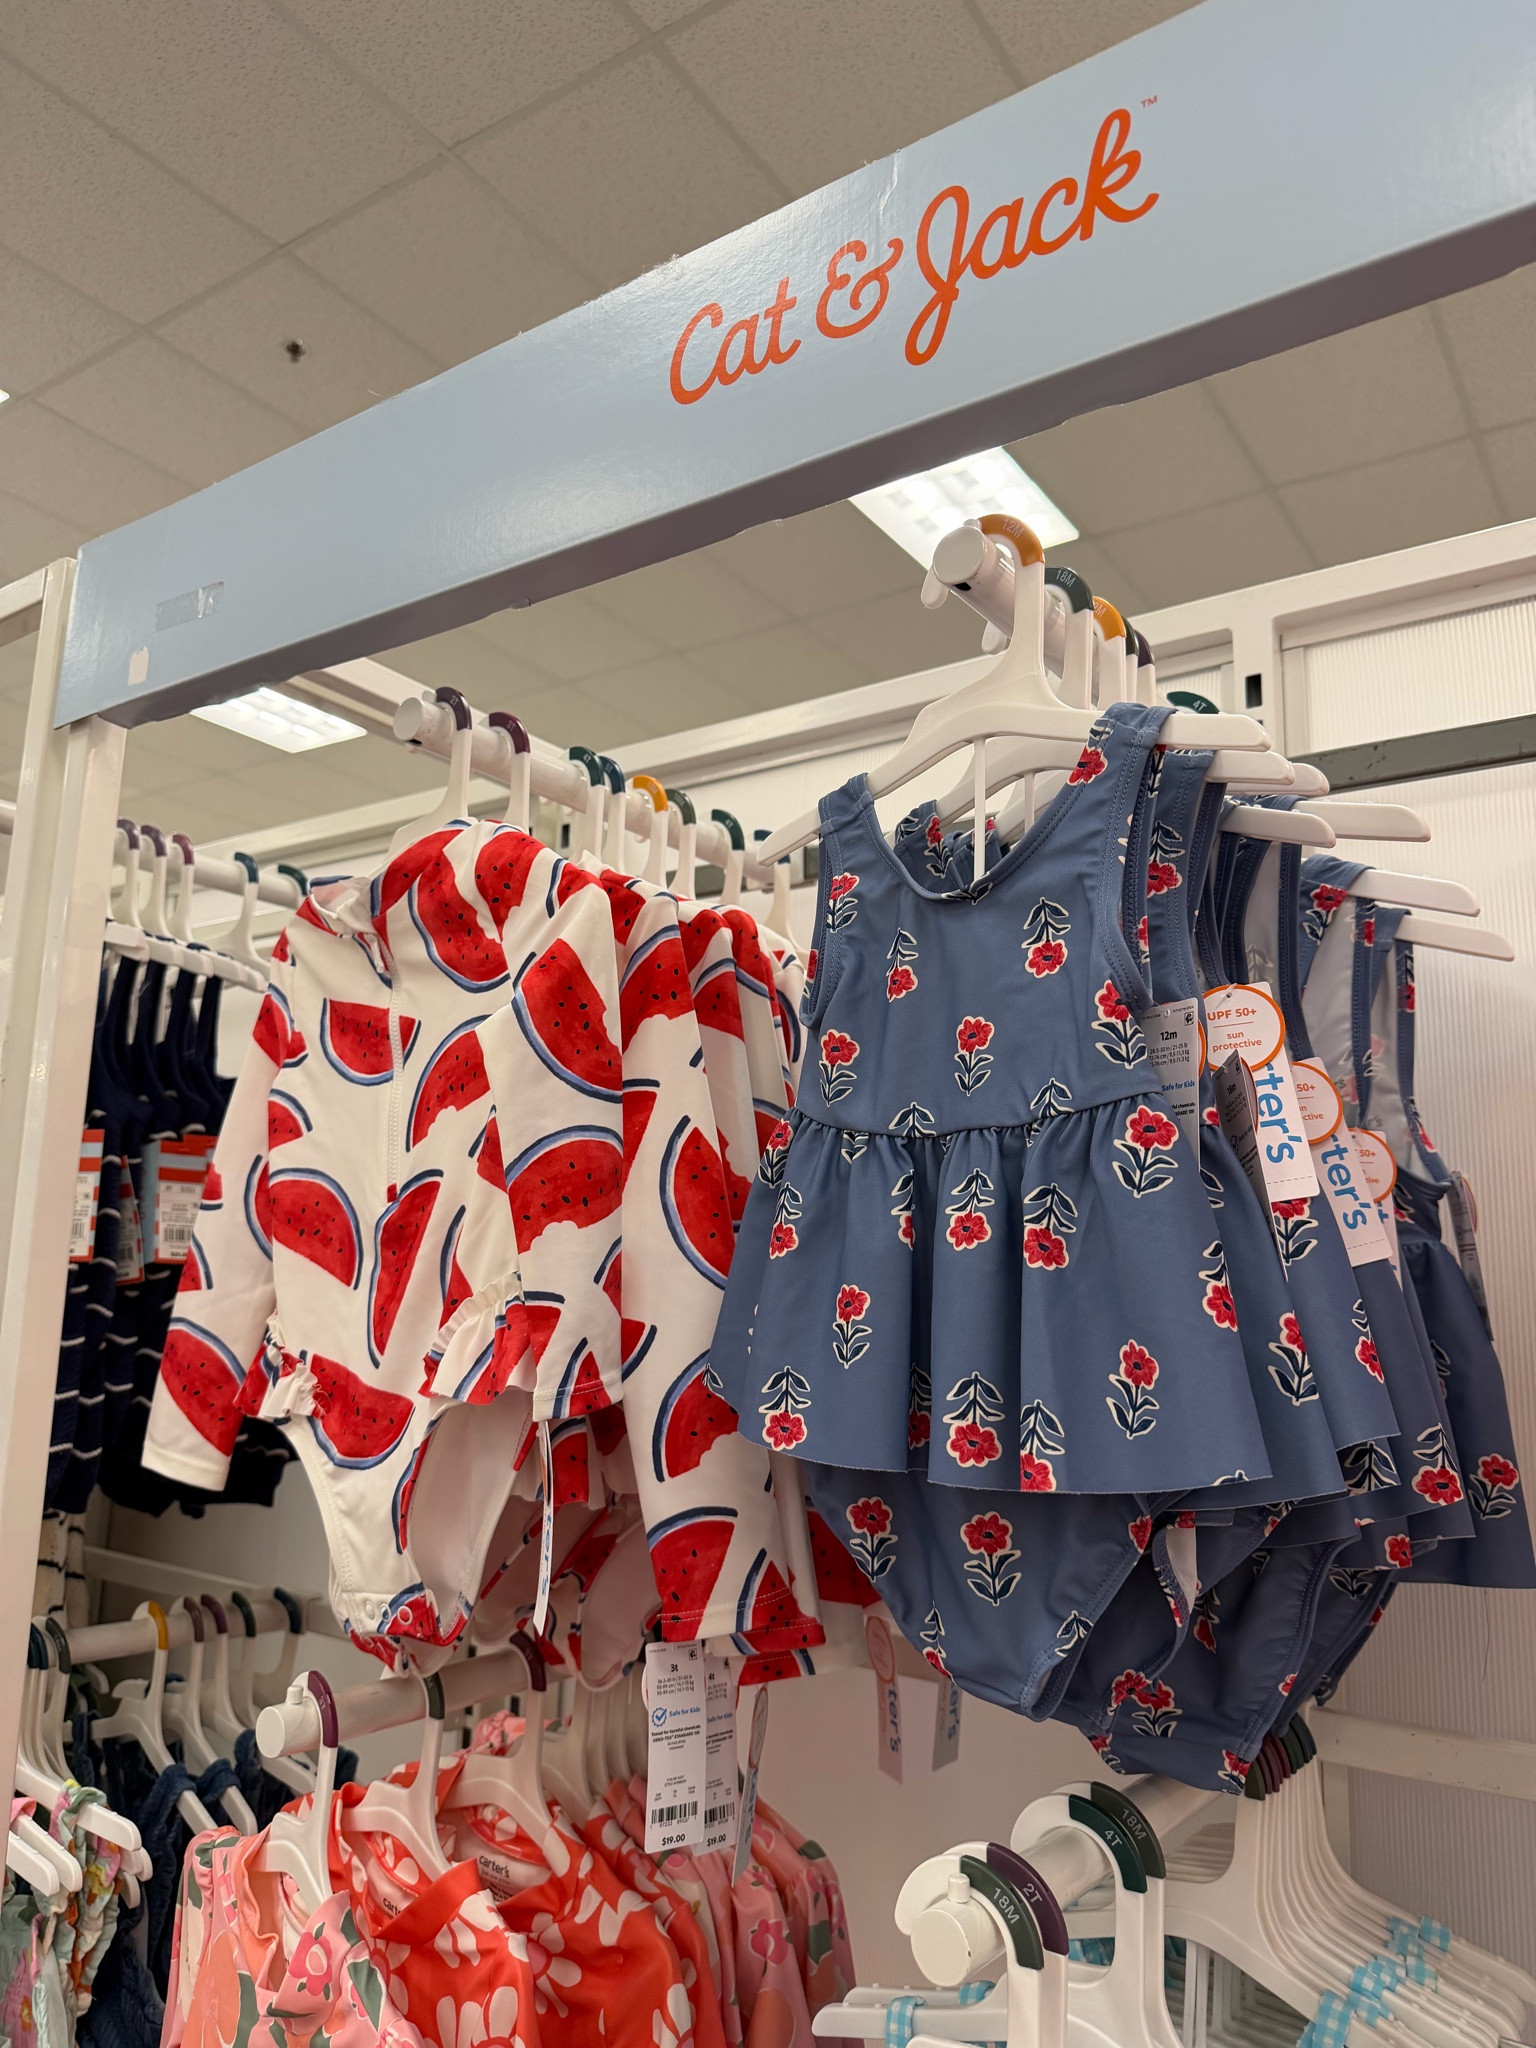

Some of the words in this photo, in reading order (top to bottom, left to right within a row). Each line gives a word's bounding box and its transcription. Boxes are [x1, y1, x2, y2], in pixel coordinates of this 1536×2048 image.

[669, 277, 802, 405] Cat
[815, 238, 904, 339] &
[904, 108, 1160, 367] Jack
[1002, 517, 1026, 539] 12M
[1055, 569, 1077, 588] 18M
[1192, 700, 1207, 712] 4T
[583, 753, 592, 764] 4T
[1207, 1009, 1232, 1021] UPF
[1235, 1007, 1257, 1018] 50+
[1160, 1031, 1178, 1041] 12m
[1226, 1031, 1244, 1040] sun
[1212, 1038, 1262, 1053] protective
[1161, 1083, 1175, 1092] Safe
[1175, 1082, 1183, 1090] for
[1184, 1080, 1195, 1088] Kids
[1296, 1083, 1316, 1093] 50+
[1255, 1062, 1303, 1164] ter's
[1359, 1149, 1376, 1158] 50+
[1320, 1131, 1372, 1230] ter's
[670, 1663, 679, 1672] 3t
[887, 1686, 902, 1753] ter's
[1121, 1808, 1148, 1841] 18M
[661, 1833, 686, 1846] $19.00
[707, 1834, 727, 1847] $19.00
[1104, 1829, 1123, 1847] 4T
[478, 1855, 510, 1879] carter's
[1022, 1883, 1043, 1904] 2T
[992, 1887, 1021, 1924] 18M
